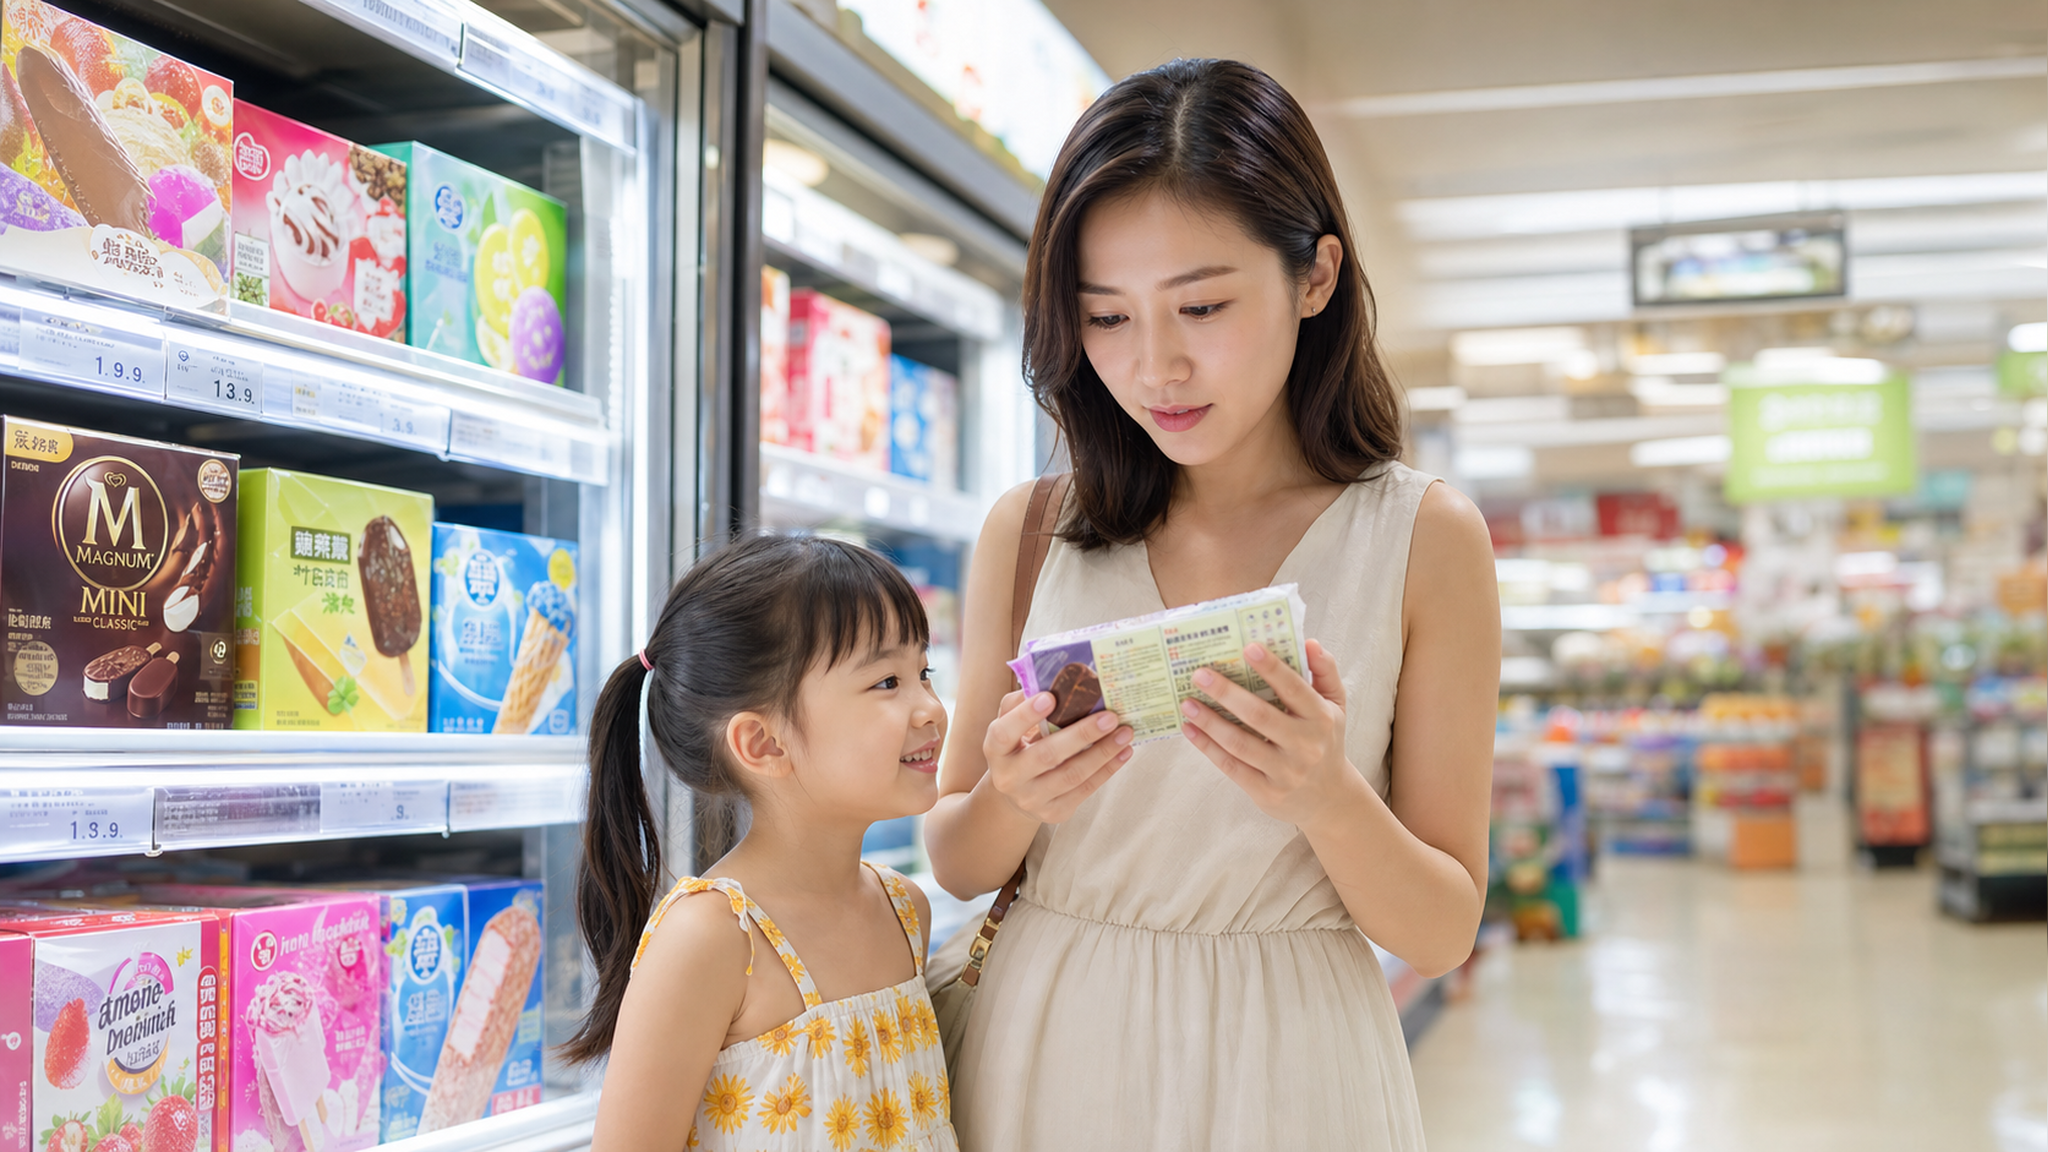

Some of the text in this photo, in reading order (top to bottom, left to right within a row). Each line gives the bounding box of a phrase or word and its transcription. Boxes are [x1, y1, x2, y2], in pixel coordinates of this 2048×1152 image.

[82, 474, 147, 550] M
[76, 545, 152, 569] MAGNUM
[80, 585, 147, 618] MINI
[92, 616, 138, 631] CLASSIC
